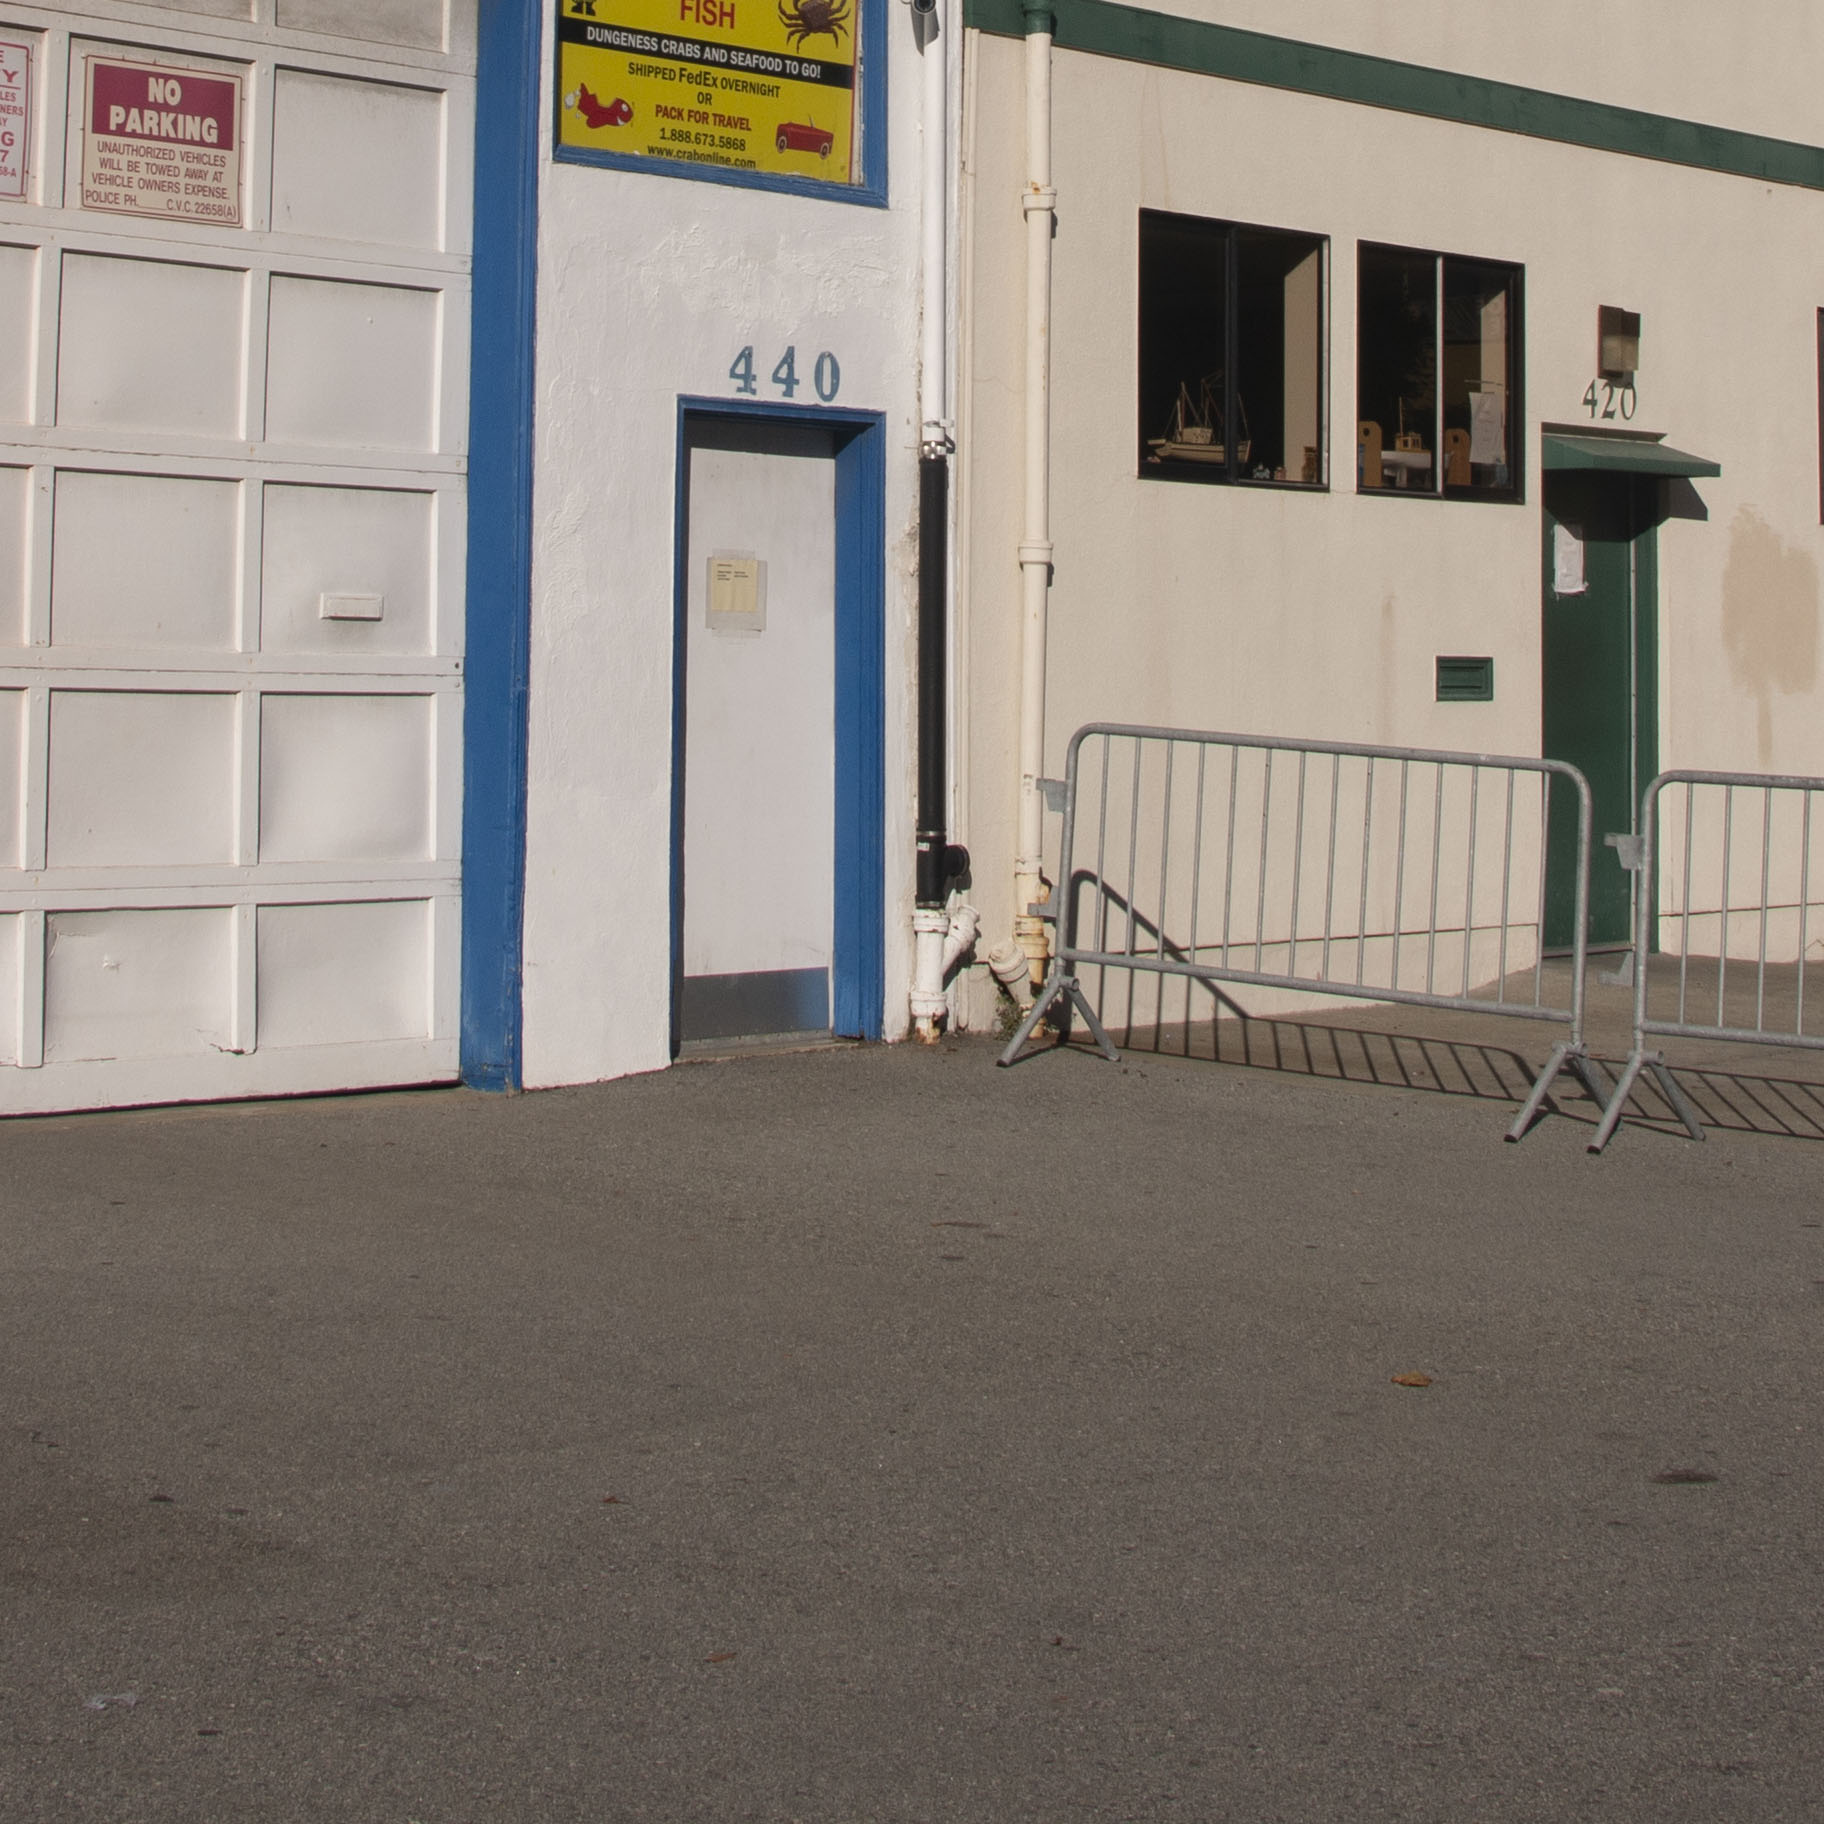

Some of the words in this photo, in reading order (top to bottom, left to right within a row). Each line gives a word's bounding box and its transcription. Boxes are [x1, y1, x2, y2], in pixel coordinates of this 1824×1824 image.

[586, 26, 659, 52] DUNGENESS
[660, 40, 701, 59] CRABS
[702, 47, 728, 64] AND
[730, 52, 783, 73] SEAFOOD
[784, 60, 800, 75] TO
[801, 63, 822, 79] GO!
[147, 77, 182, 106] NO
[627, 61, 677, 83] SHIPPED
[678, 67, 719, 89] FedEx
[720, 77, 782, 99] OVERNIGHT
[696, 91, 713, 107] OR
[109, 104, 219, 144] PARKING
[655, 104, 685, 122] PACK
[687, 108, 710, 126] FOR
[711, 111, 753, 132] TRAVEL
[97, 140, 176, 162] UNAUTHORIZED
[179, 150, 226, 168] VEHICLES
[659, 127, 747, 152] 1.888.673.5868
[99, 157, 123, 172] WILL
[126, 160, 141, 174] BE
[144, 162, 181, 178] TOWED
[184, 167, 210, 182] AWAY
[212, 170, 224, 184] AT
[646, 142, 757, 170] www.crabonline.com
[91, 172, 134, 189] VEHICLE
[137, 177, 181, 194] OWNERS
[184, 182, 230, 201] EXPENSE.
[85, 189, 121, 205] POLICE
[194, 201, 237, 220] 22658(A)
[728, 345, 841, 403] 440
[1581, 378, 1638, 421] 420
